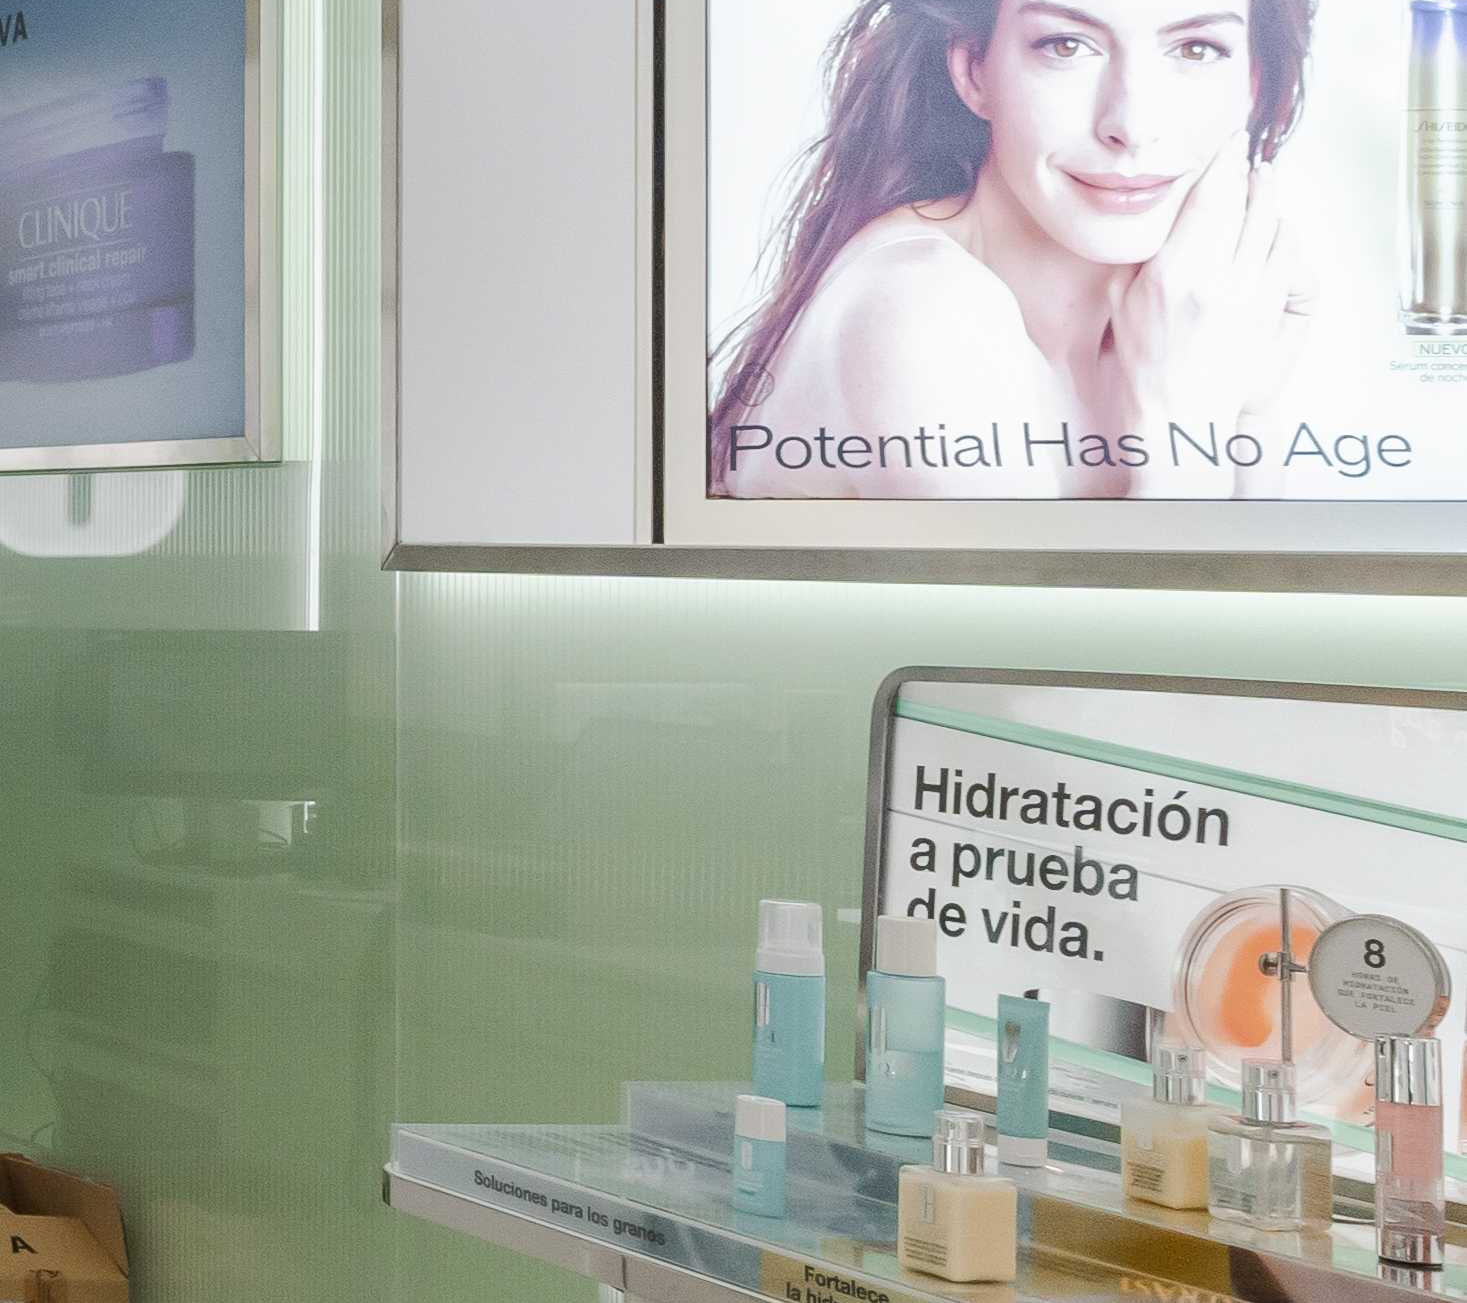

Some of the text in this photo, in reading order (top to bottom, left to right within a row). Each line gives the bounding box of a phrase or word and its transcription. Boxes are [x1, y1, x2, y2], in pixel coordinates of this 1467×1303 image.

[19, 190, 132, 249] CLINIQUE
[49, 246, 145, 278] clinical repair
[729, 420, 1413, 477] Potential Has No Age
[913, 764, 1230, 848] Hidratación
[909, 838, 1141, 902] a prueba
[906, 890, 1106, 963] de vida.
[1363, 938, 1386, 968] 8
[1355, 1000, 1397, 1013] LA PIEL
[474, 1169, 666, 1246] Soluciones para los granos
[10, 1235, 39, 1254] A
